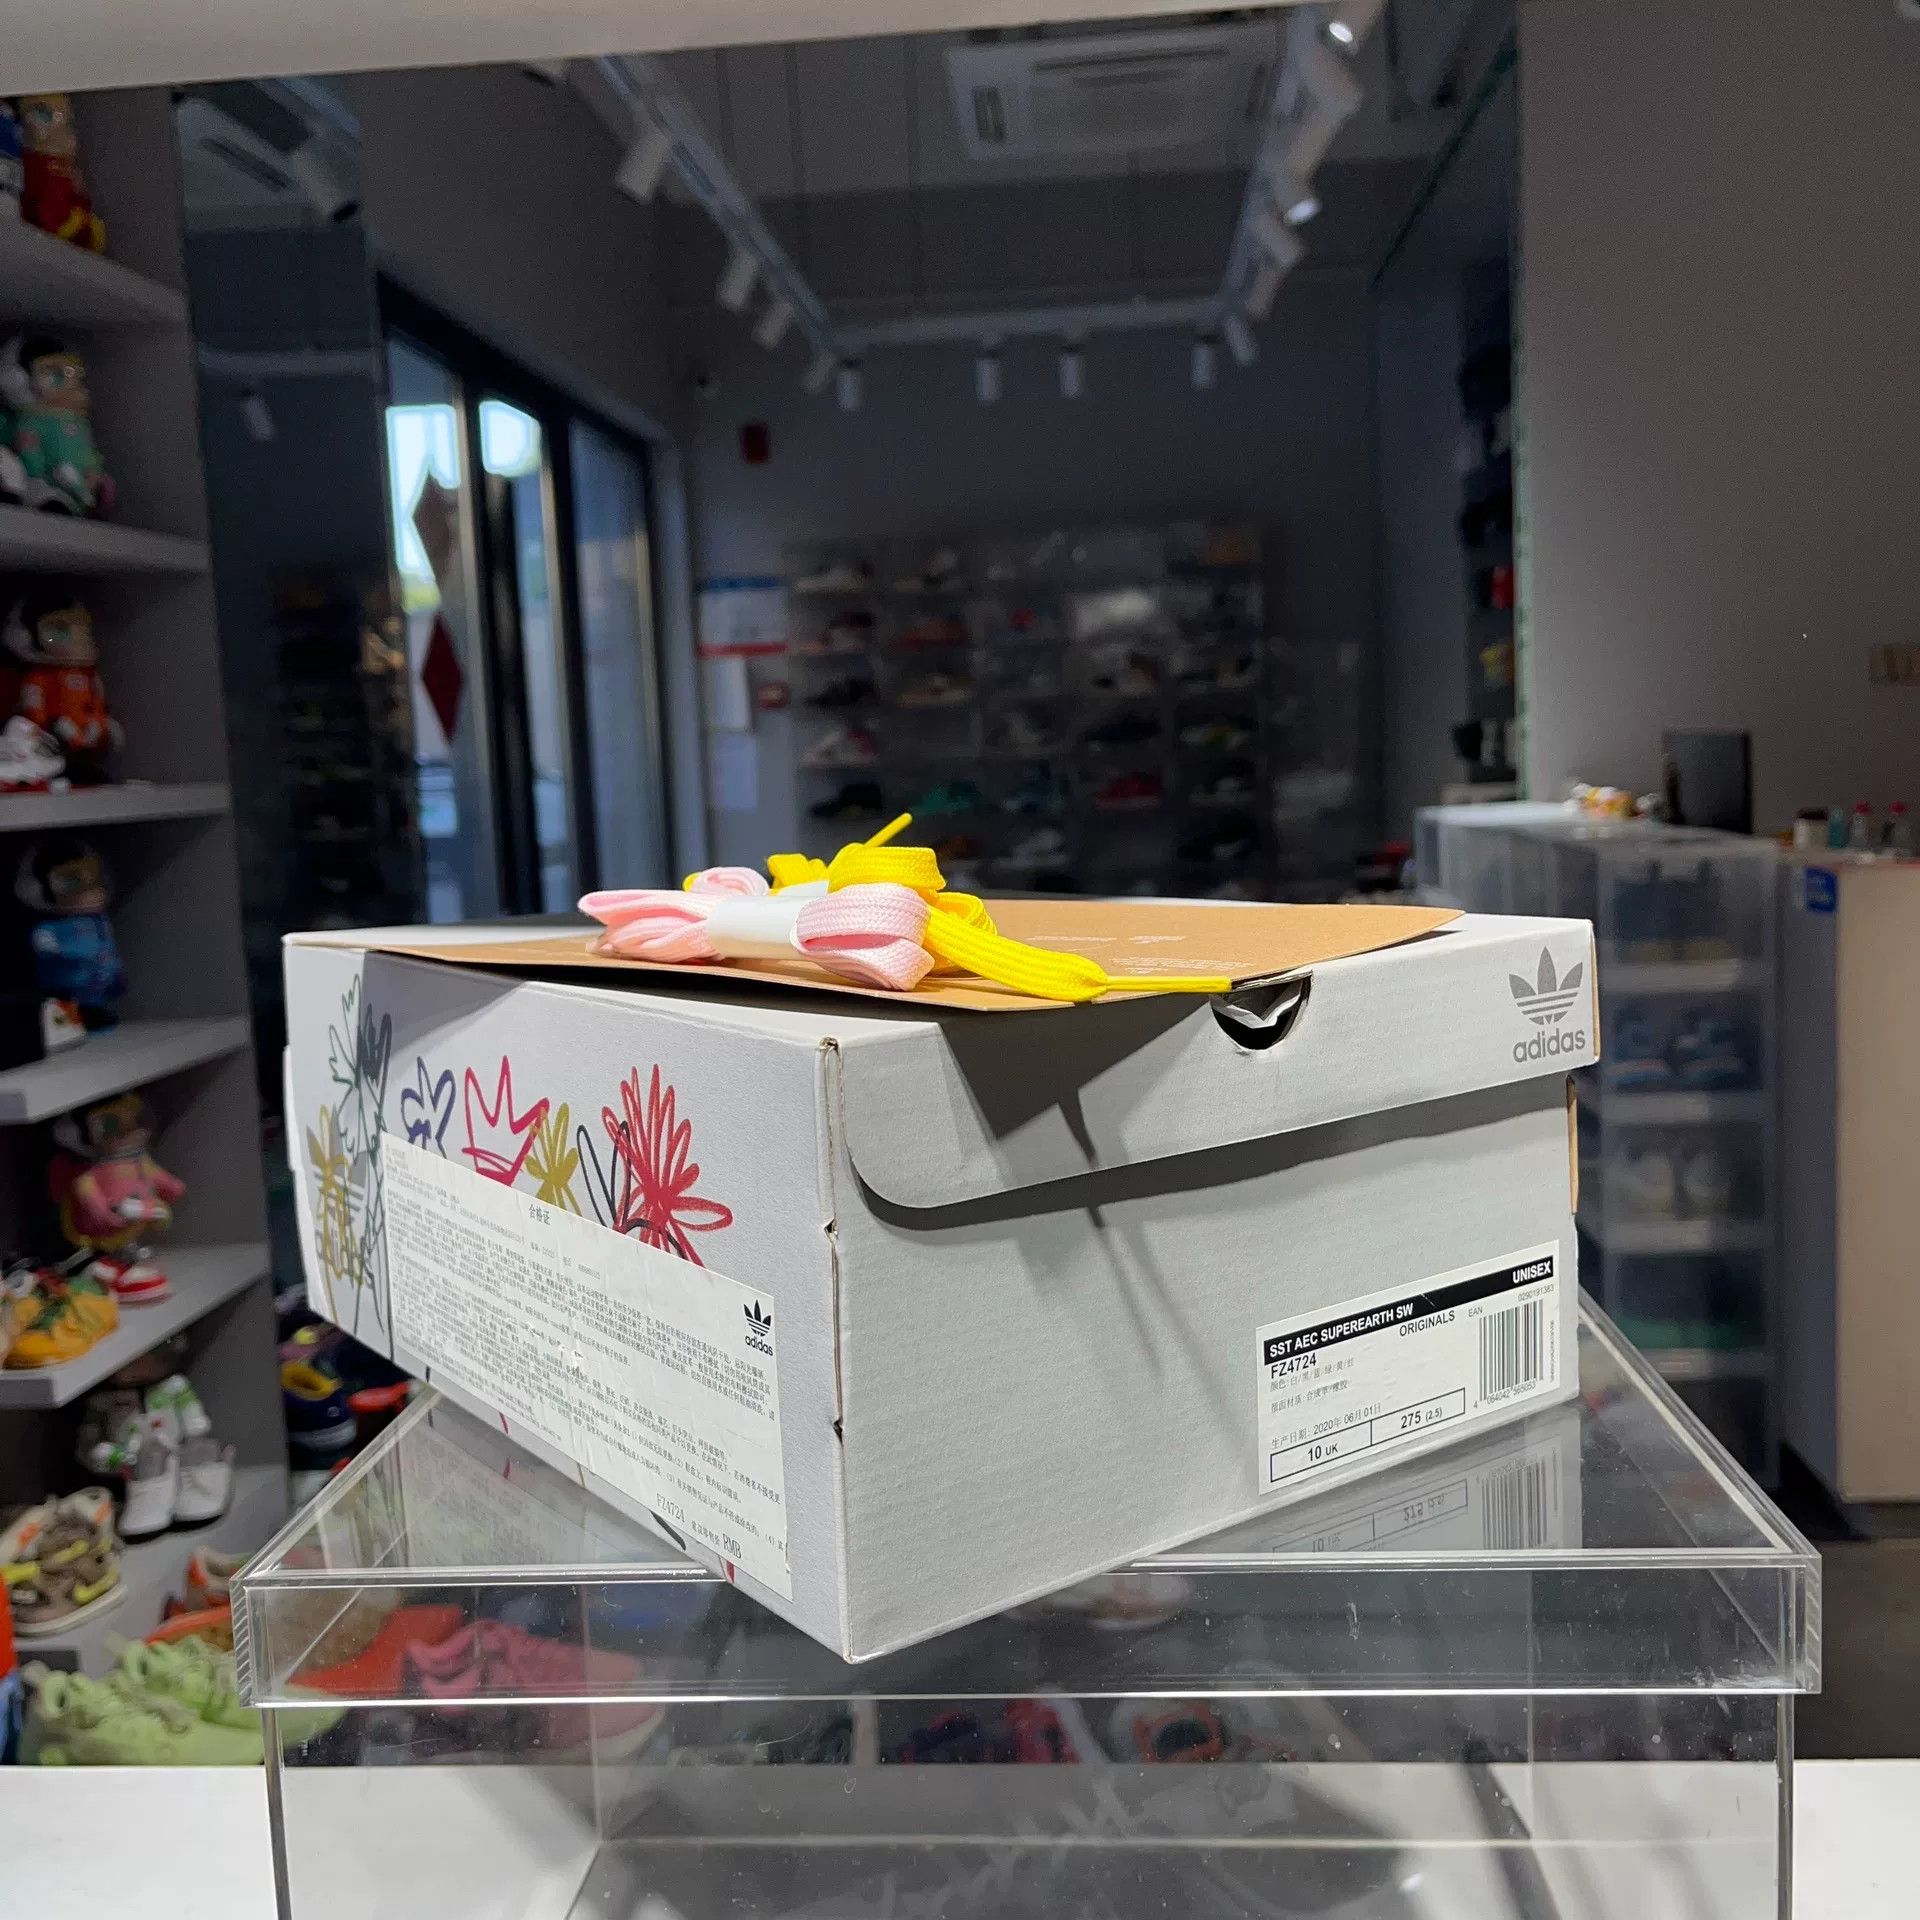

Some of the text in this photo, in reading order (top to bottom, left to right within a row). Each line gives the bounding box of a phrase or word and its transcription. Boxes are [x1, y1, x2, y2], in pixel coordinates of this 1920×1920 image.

[1512, 1028, 1586, 1063] adidas
[528, 1204, 551, 1226] 合格证
[1269, 1260, 1552, 1358] SST AEC SUPEREARTH SW UNISEX
[1468, 1306, 1483, 1318] EAN
[1399, 1310, 1456, 1337] ORIGINALS
[744, 1335, 774, 1357] adidas
[1270, 1352, 1317, 1380] FZ4724
[1400, 1406, 1443, 1430] 275 (2.5)
[1307, 1442, 1339, 1462] 10 UK
[722, 1533, 742, 1559] RMB
